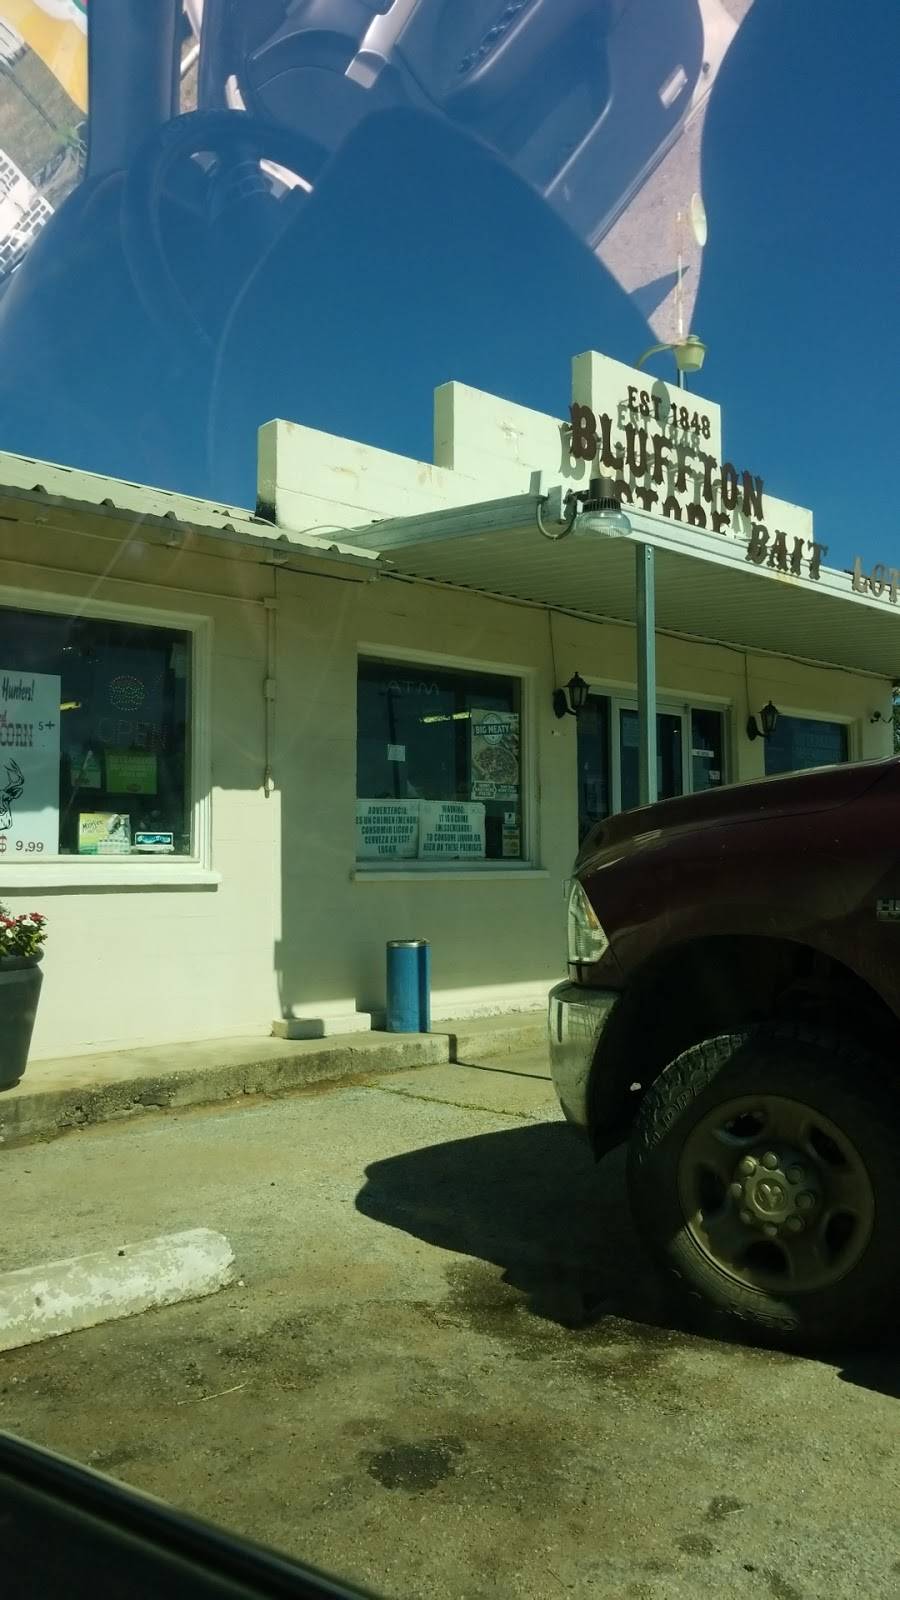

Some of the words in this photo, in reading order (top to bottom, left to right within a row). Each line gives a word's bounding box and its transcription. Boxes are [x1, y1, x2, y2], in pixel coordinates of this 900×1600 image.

[627, 385, 662, 421] EST
[671, 402, 711, 440] 1848
[569, 402, 765, 521] BLUFFTON
[746, 521, 828, 581] BAIT
[475, 725, 487, 734] BIG
[488, 724, 509, 734] MEATY
[15, 840, 44, 853] 9.99
